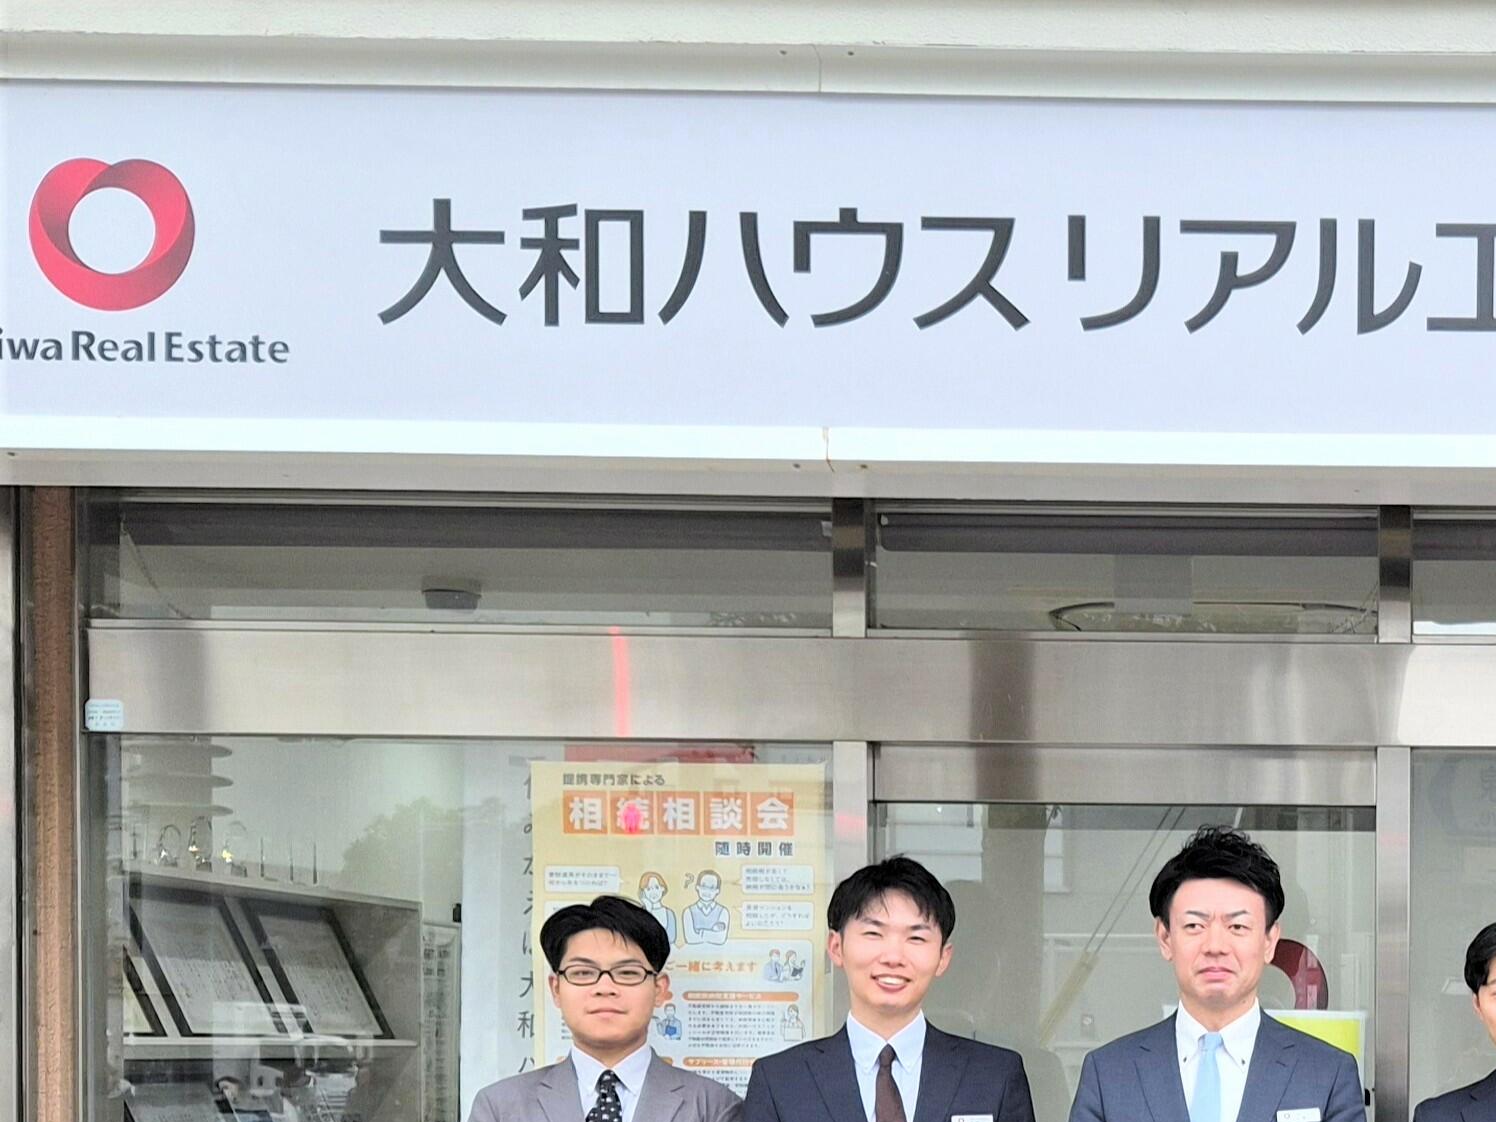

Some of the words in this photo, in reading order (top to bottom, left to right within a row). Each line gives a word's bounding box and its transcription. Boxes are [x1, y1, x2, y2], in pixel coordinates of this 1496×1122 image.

[377, 197, 1031, 331] 大和ハウス
[71, 330, 156, 363] Real
[164, 331, 290, 364] Estate
[714, 841, 794, 857] 随時開催
